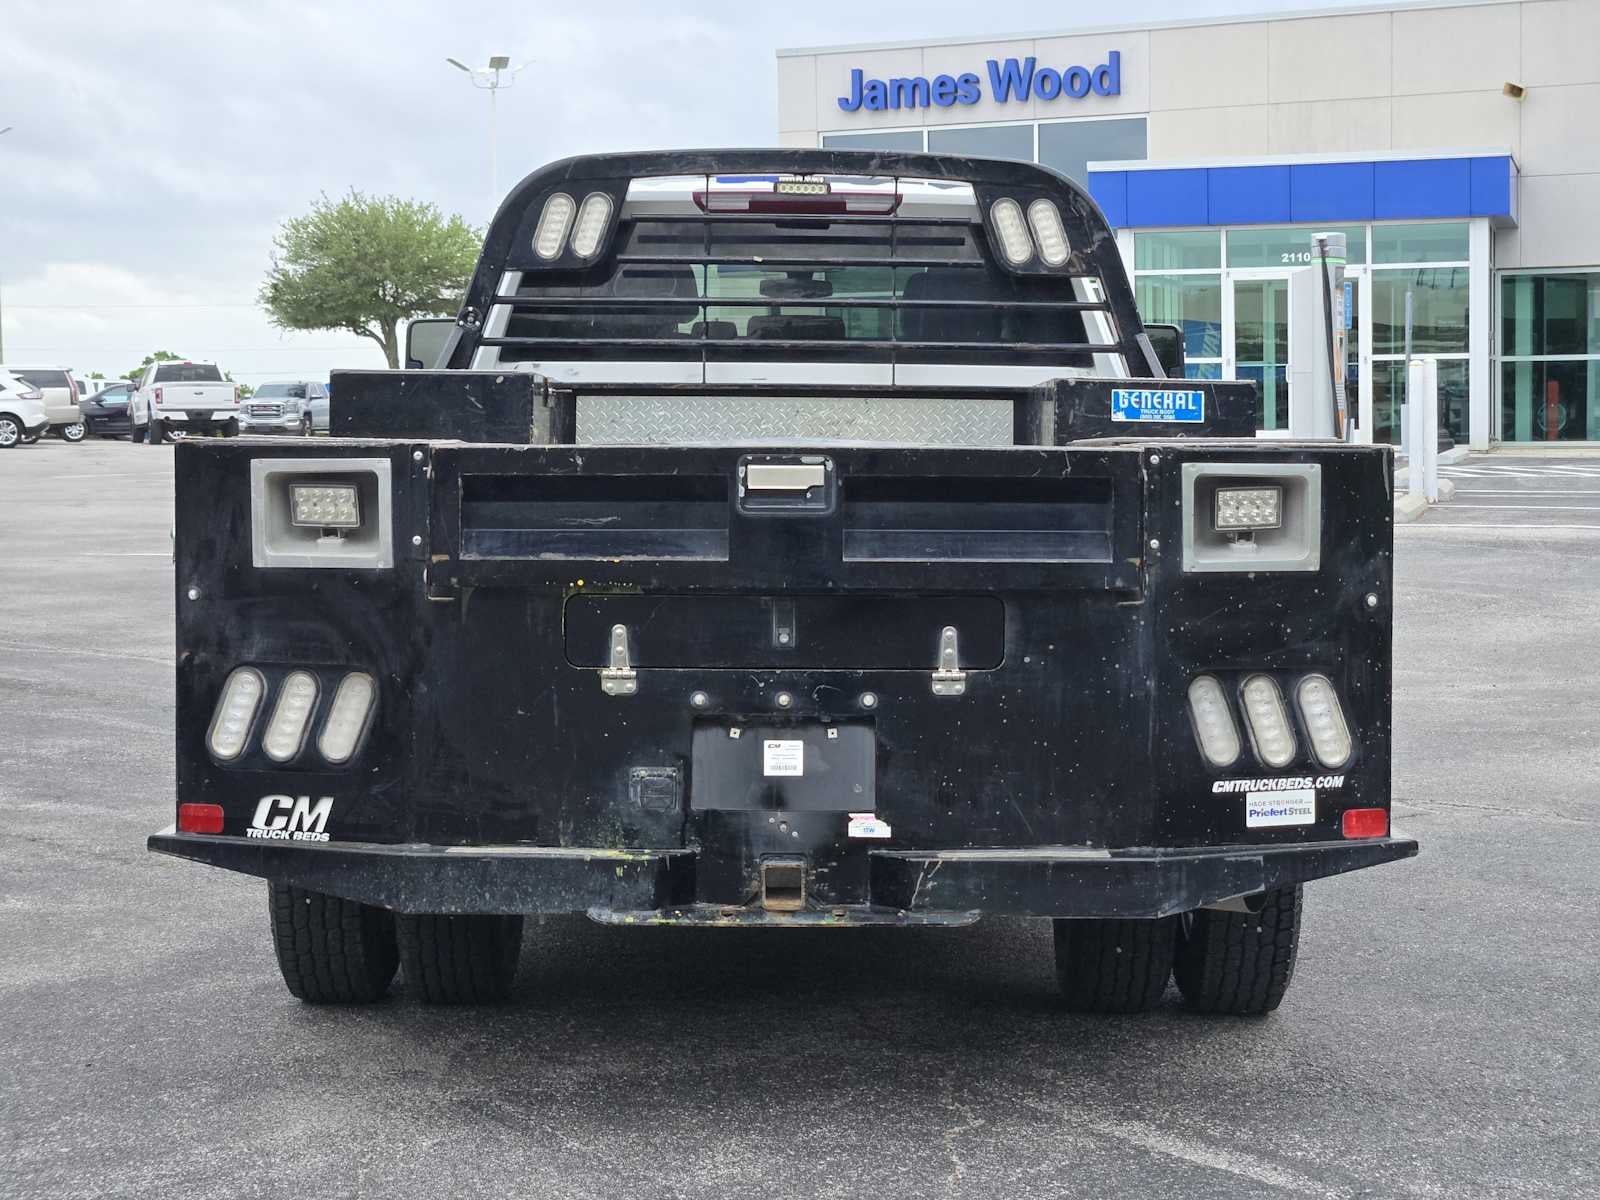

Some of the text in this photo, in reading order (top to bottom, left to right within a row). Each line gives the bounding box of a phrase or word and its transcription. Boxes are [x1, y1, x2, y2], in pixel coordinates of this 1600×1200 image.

[838, 50, 1121, 113] James Wood
[1281, 252, 1311, 263] 2110
[1119, 391, 1196, 410] GENERAL
[1212, 775, 1345, 793] CMTRUCKBEDS.COM
[252, 794, 334, 833] CM
[1249, 807, 1312, 818] Priefert STEEL
[246, 828, 330, 842] TRUCK BEDS
